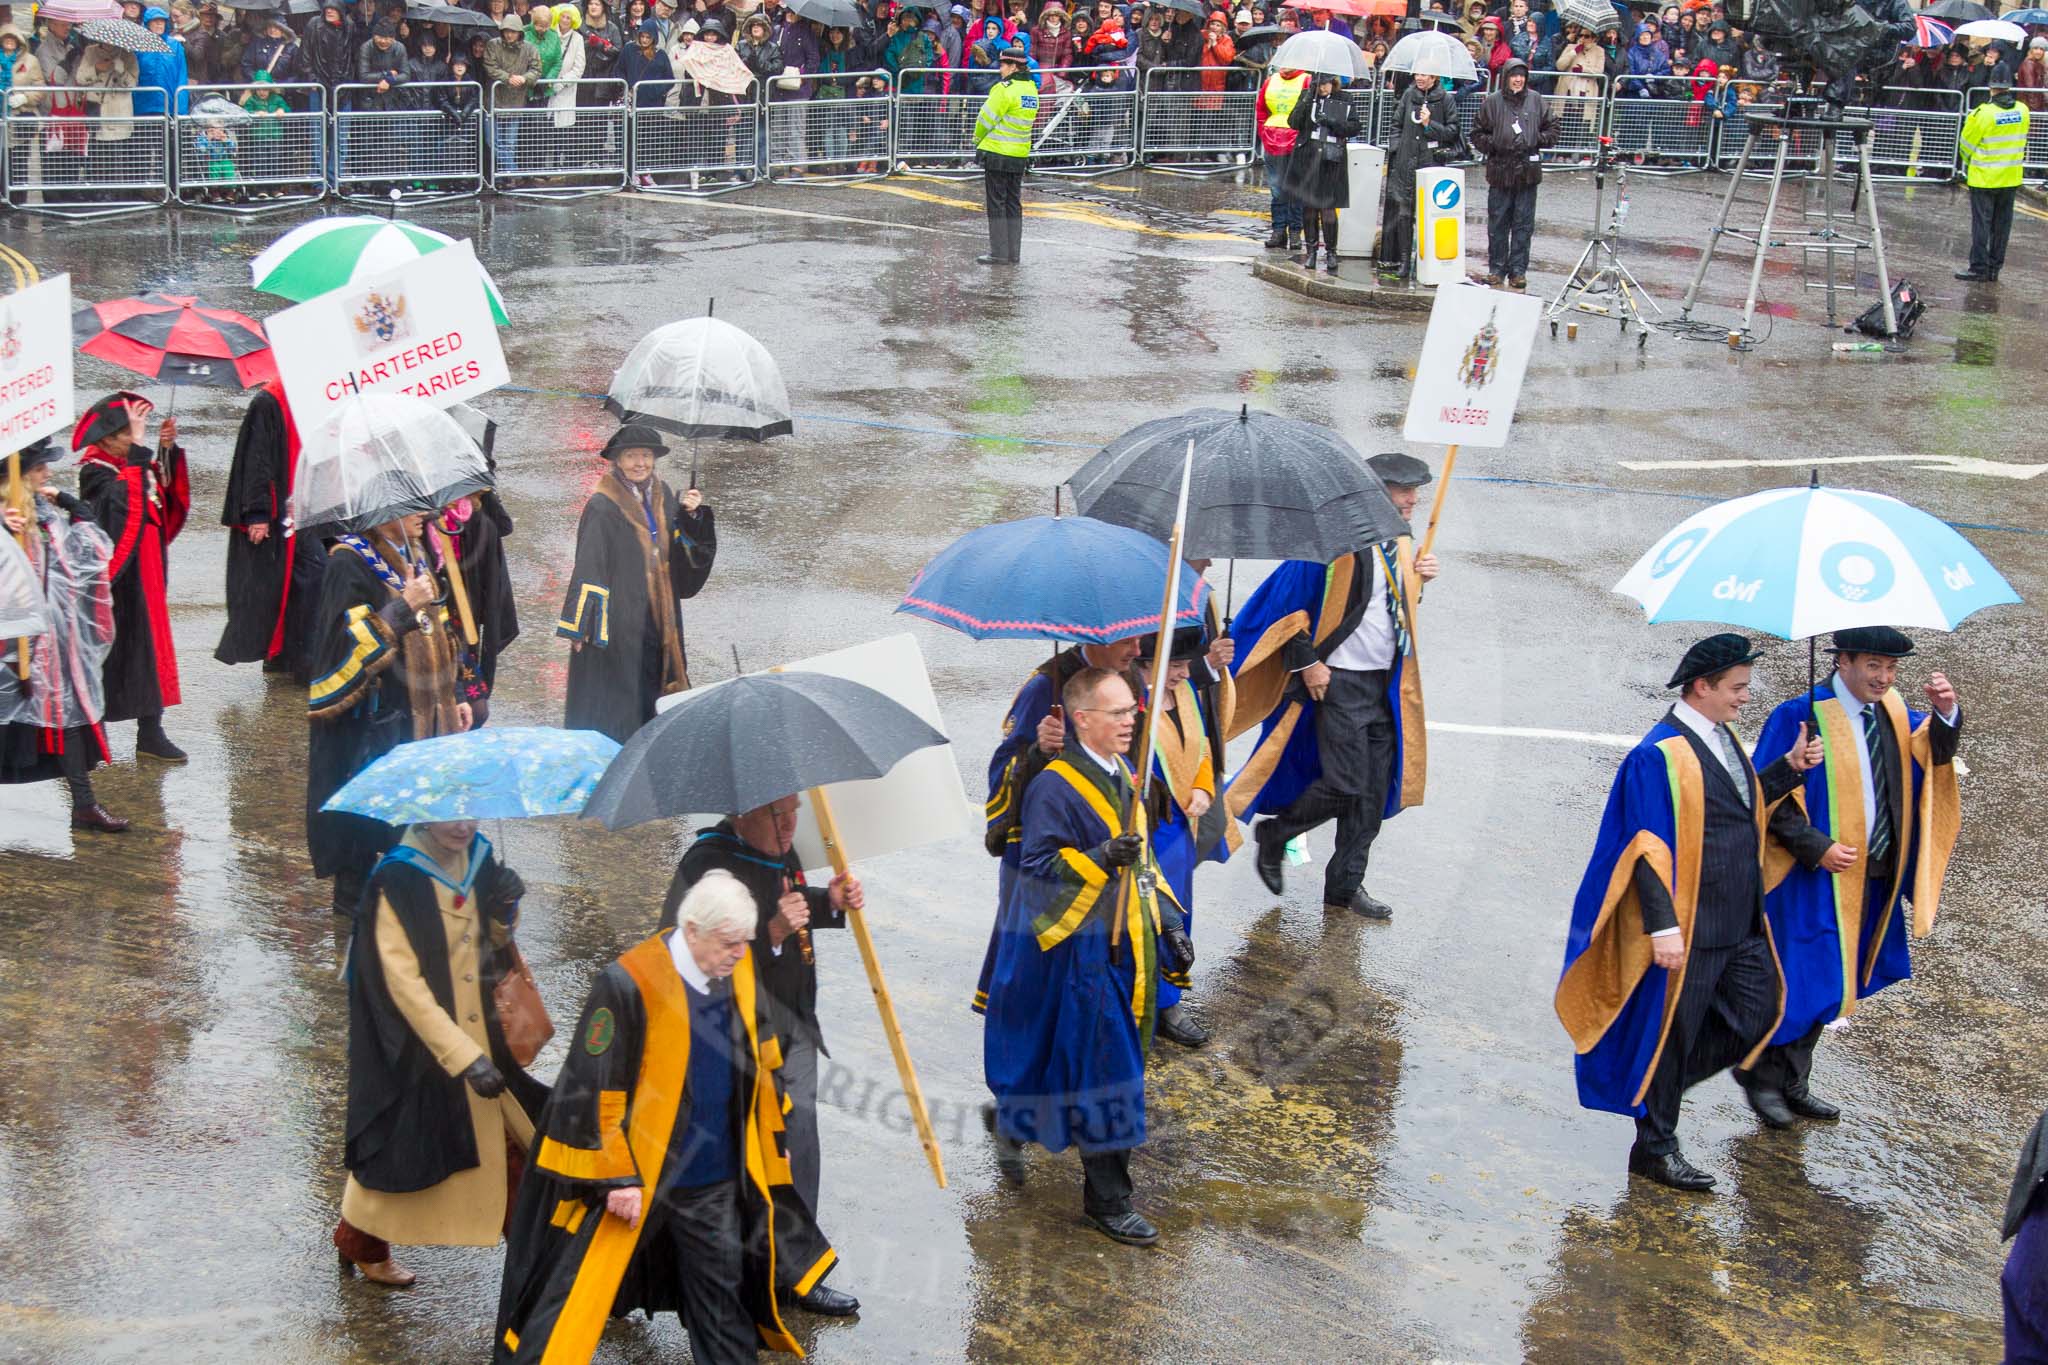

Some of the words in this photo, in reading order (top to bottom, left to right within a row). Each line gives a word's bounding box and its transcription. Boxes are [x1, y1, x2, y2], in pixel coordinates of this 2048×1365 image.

[325, 332, 463, 401] CHARTERED
[1439, 406, 1489, 427] INSURERS
[1712, 575, 1766, 604] dwf
